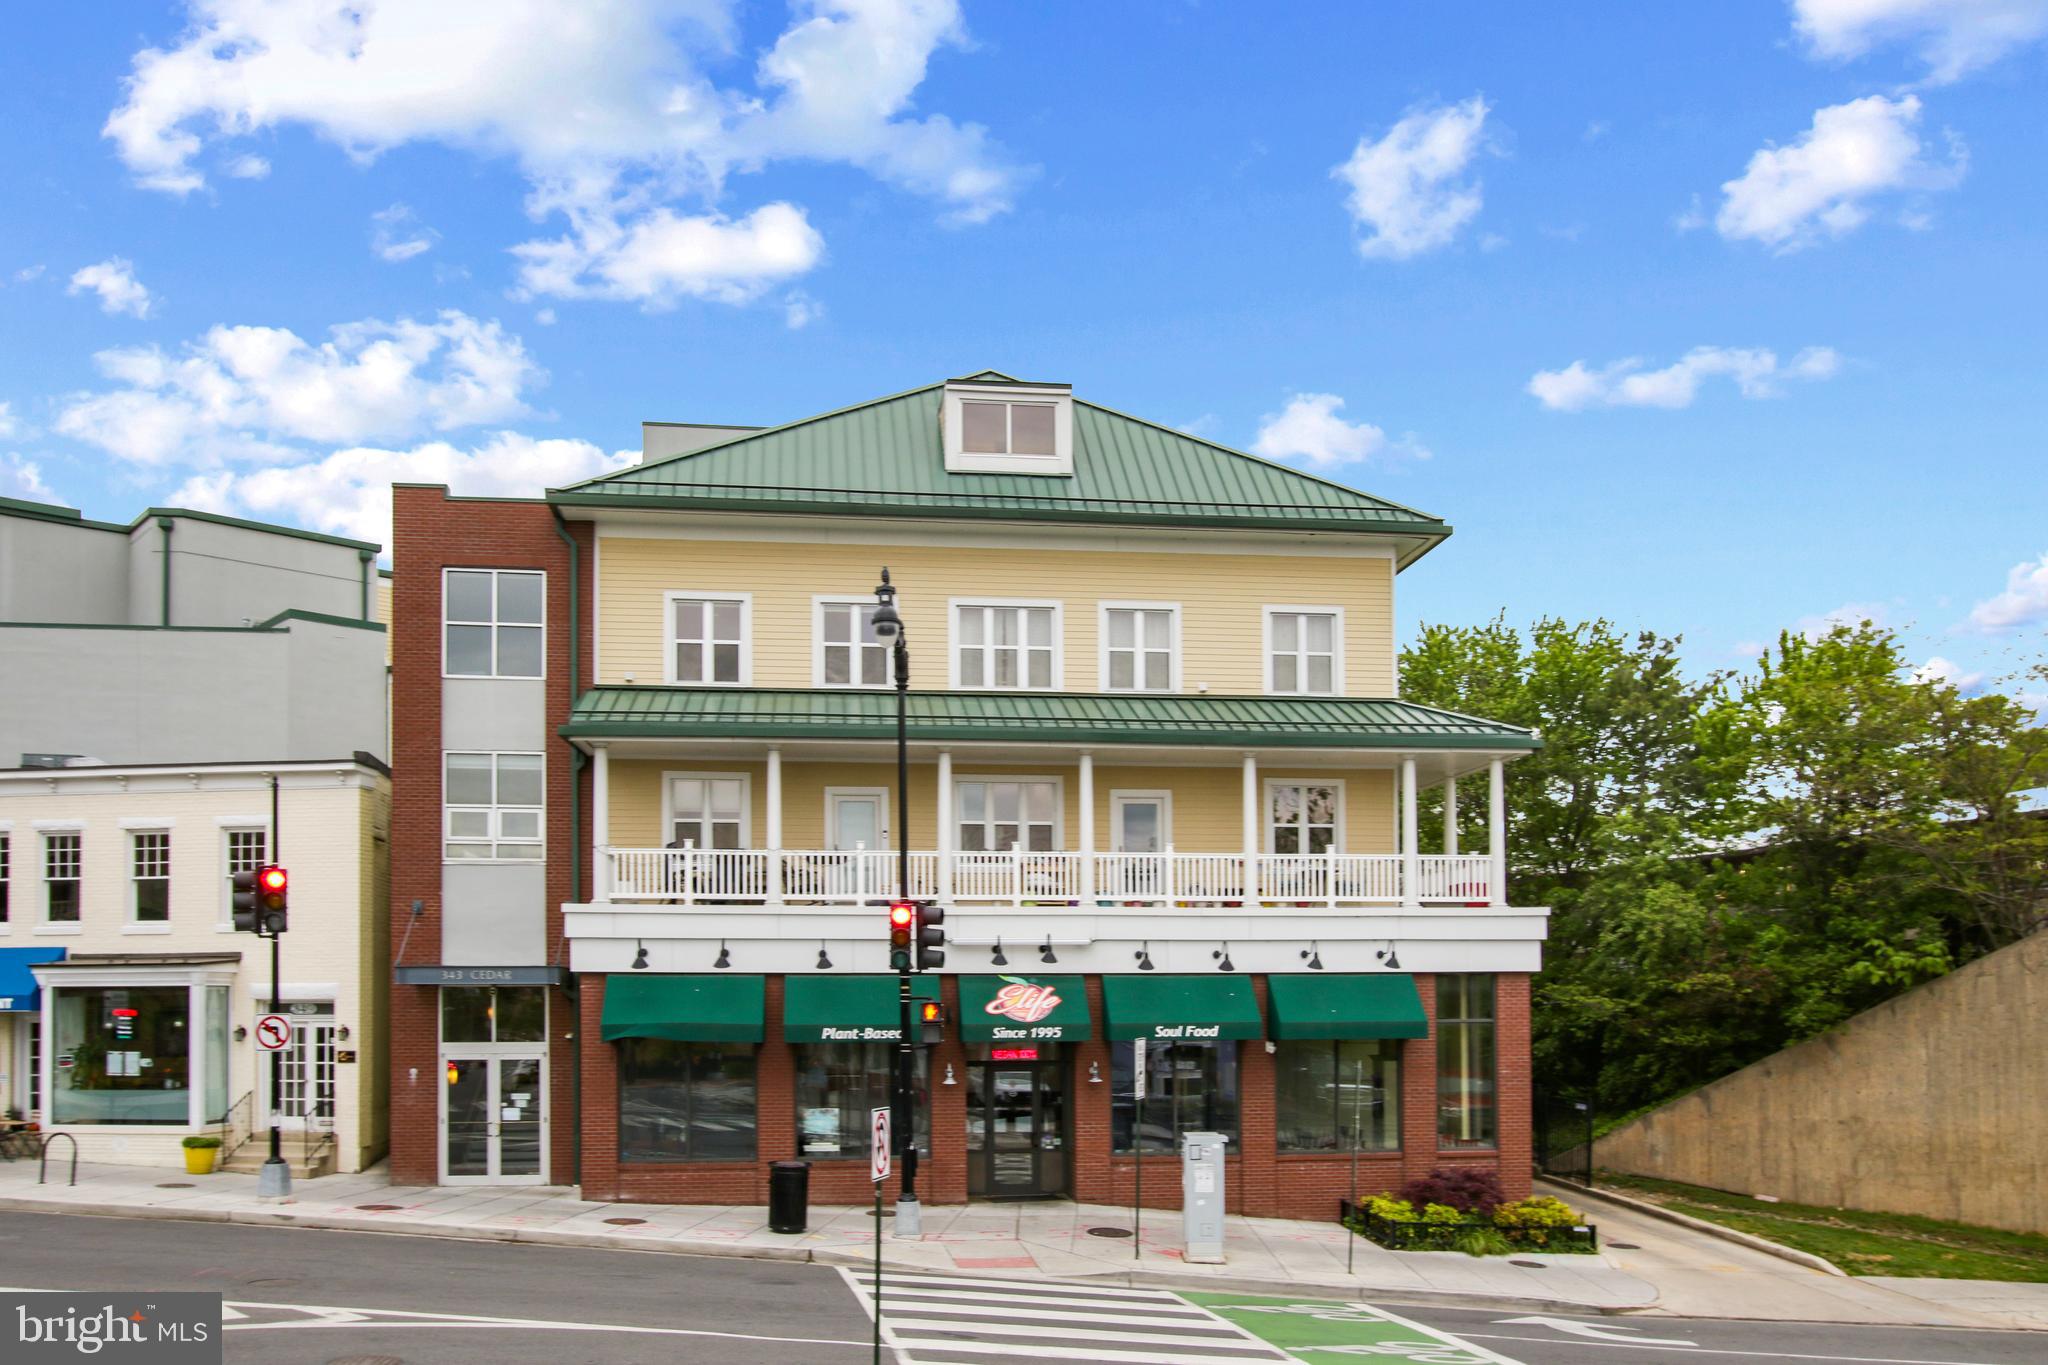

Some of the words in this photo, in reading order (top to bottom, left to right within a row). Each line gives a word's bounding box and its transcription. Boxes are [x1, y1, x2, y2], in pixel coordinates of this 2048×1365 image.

[441, 970, 463, 980] 343
[470, 970, 512, 980] CEDAR
[992, 1027, 1027, 1039] Since
[1030, 1027, 1063, 1038] 1995
[1154, 1025, 1183, 1037] Soul
[1185, 1025, 1219, 1037] Food
